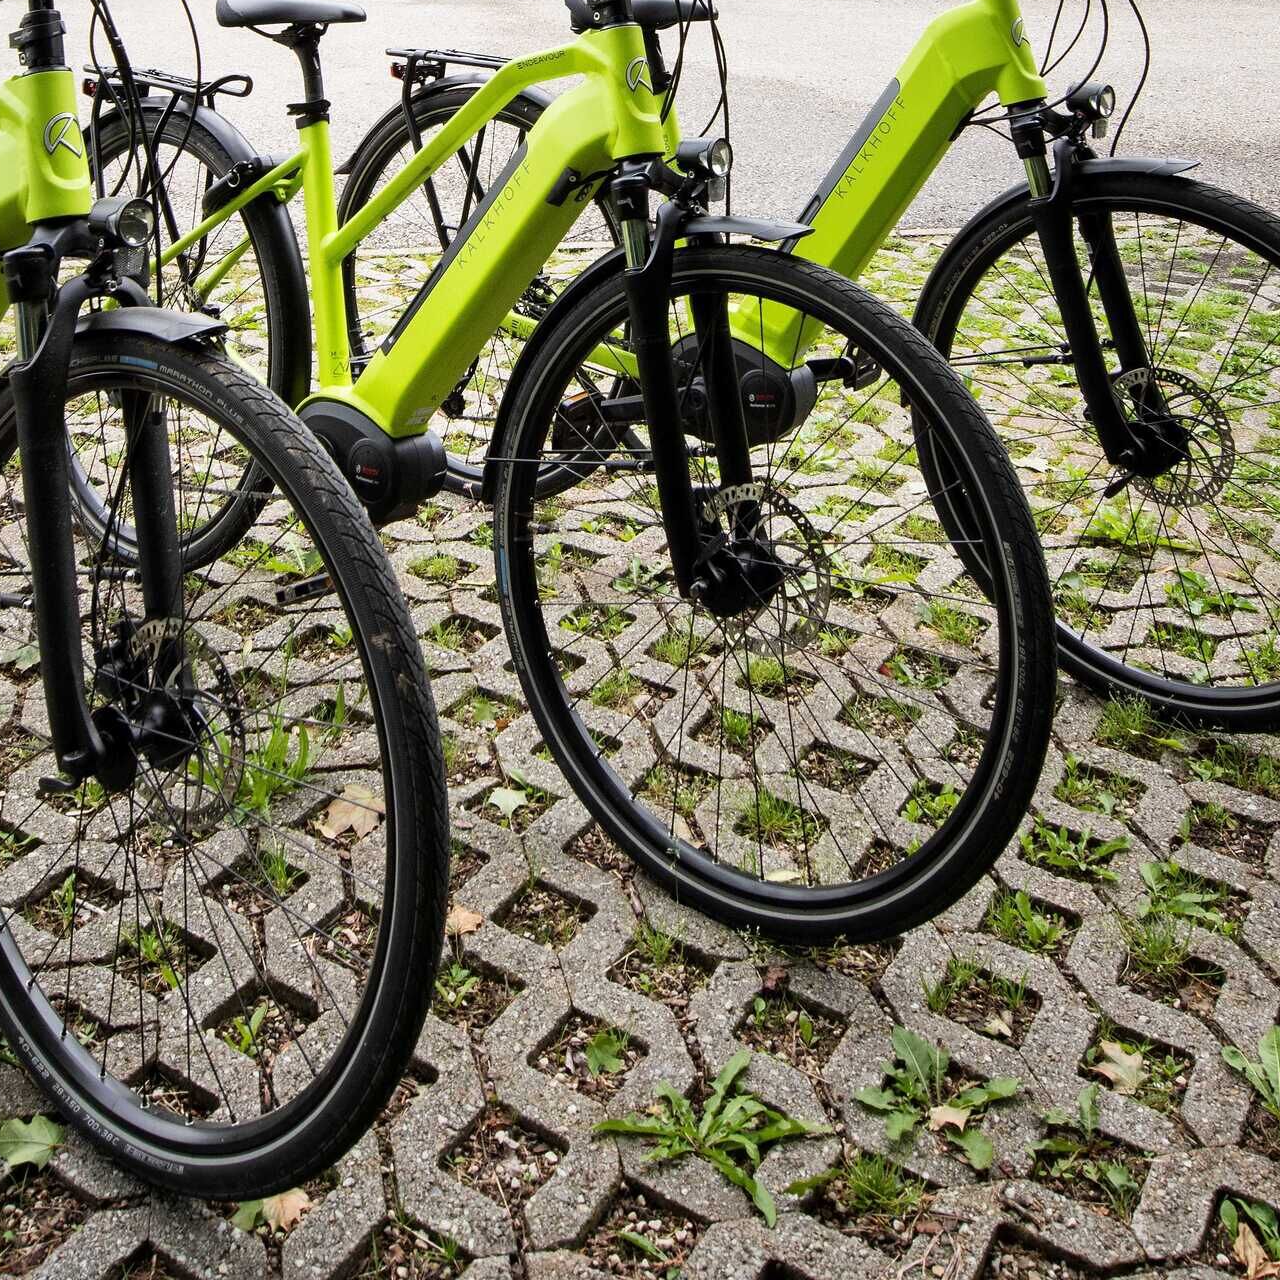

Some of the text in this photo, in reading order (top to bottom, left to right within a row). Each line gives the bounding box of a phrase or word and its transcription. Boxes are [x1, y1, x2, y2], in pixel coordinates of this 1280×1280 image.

[516, 50, 566, 70] ENDEAVOUR
[834, 95, 905, 200] KALKHOFF
[457, 160, 531, 269] KALKHOFF
[160, 365, 214, 399] MARATHON
